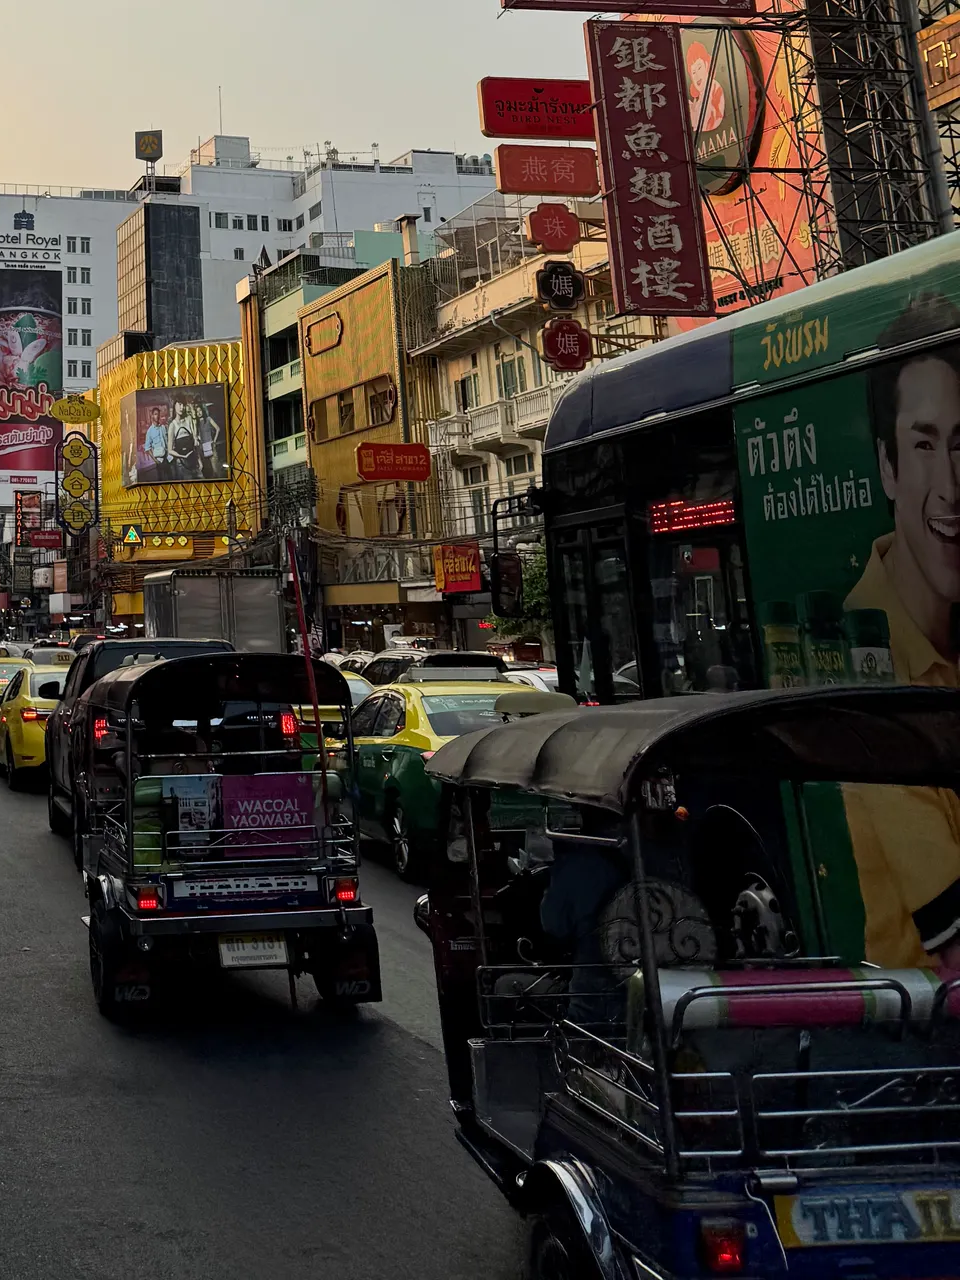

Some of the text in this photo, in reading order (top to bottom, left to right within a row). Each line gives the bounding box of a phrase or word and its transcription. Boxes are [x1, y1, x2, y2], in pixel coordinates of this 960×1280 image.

[511, 114, 577, 125] BIRD NEST
[696, 126, 738, 161] MAMA
[606, 35, 695, 303] 銀都魚翅酒樓
[25, 233, 61, 249] Royal
[746, 407, 818, 477] ตัวตึง
[57, 654, 70, 662] TAXI
[237, 798, 300, 814] WACOAL
[230, 812, 308, 828] YAOWARAT
